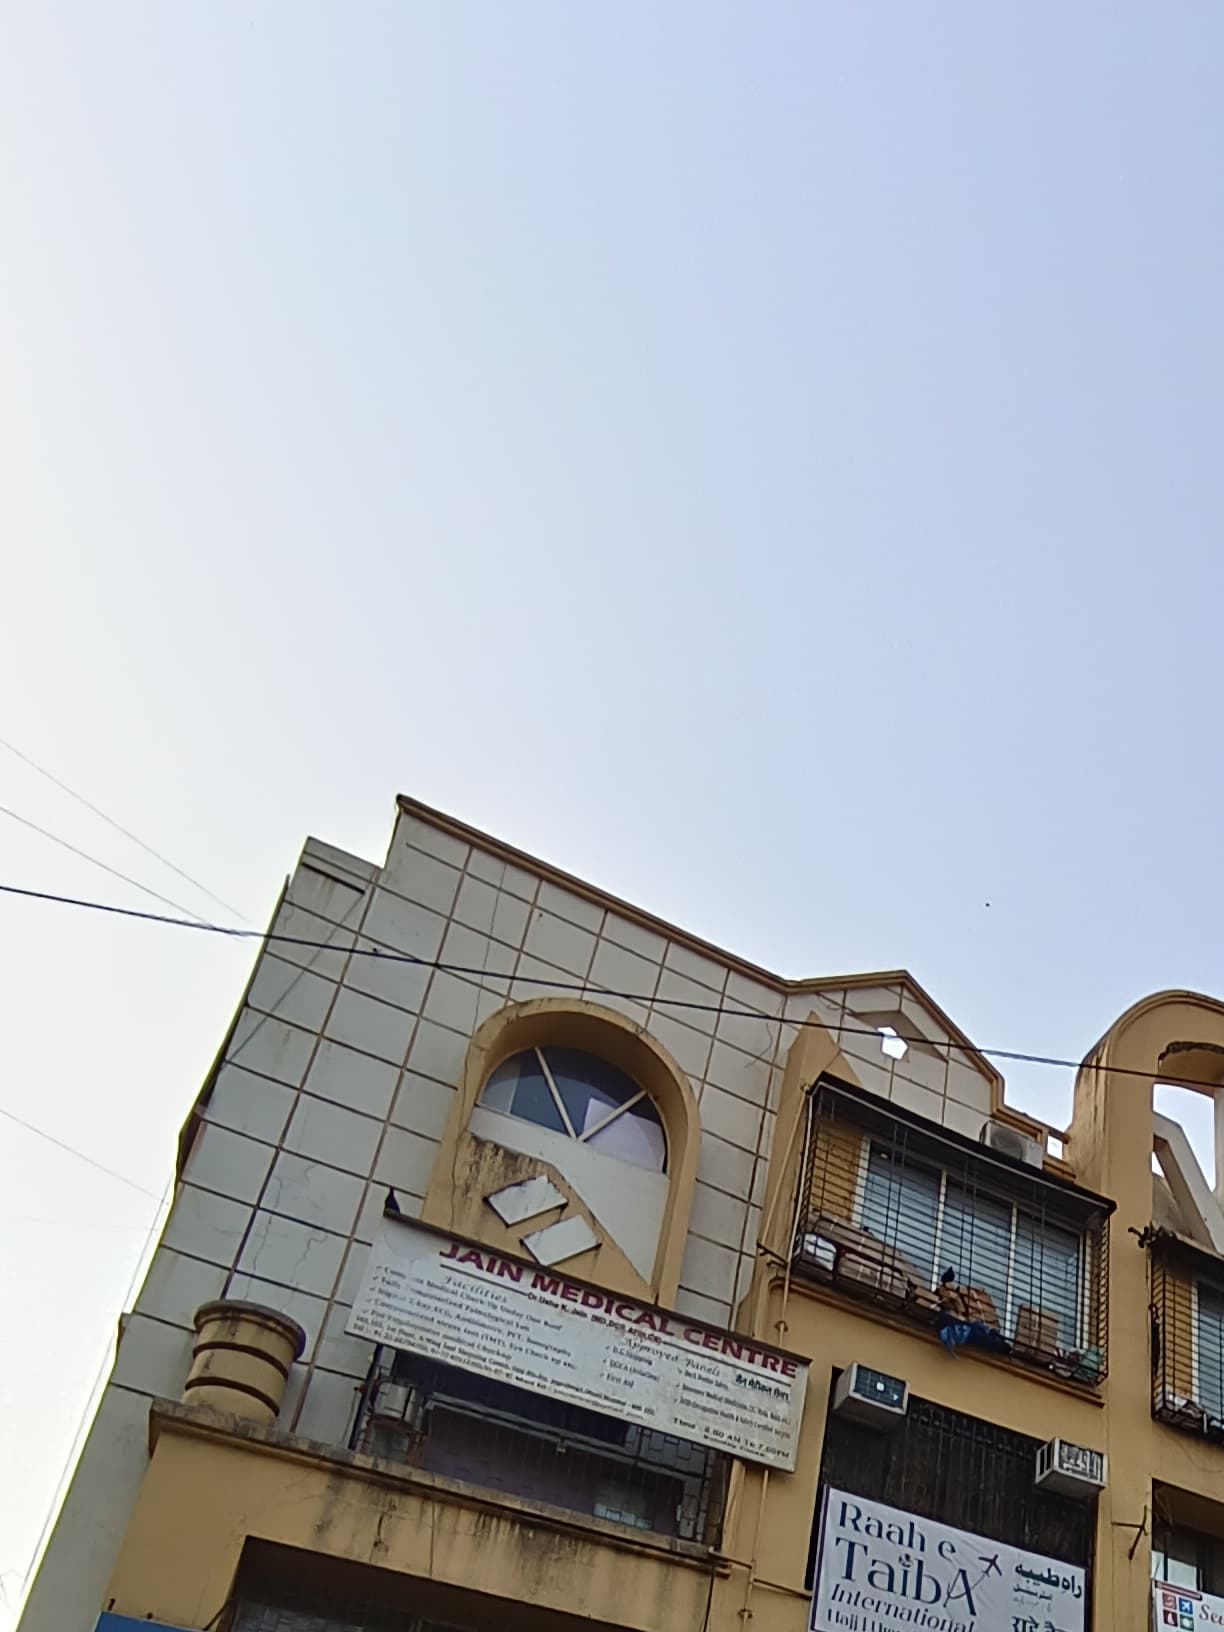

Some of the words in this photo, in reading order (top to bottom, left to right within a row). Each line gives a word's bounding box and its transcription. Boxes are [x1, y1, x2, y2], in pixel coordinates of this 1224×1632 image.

[439, 1243, 524, 1283] JAIN
[531, 1272, 674, 1336] MEDICAL
[684, 1327, 799, 1379] CENTRE
[837, 1500, 927, 1553] Raah
[937, 1537, 956, 1562] e
[826, 1607, 859, 1632] Hajj
